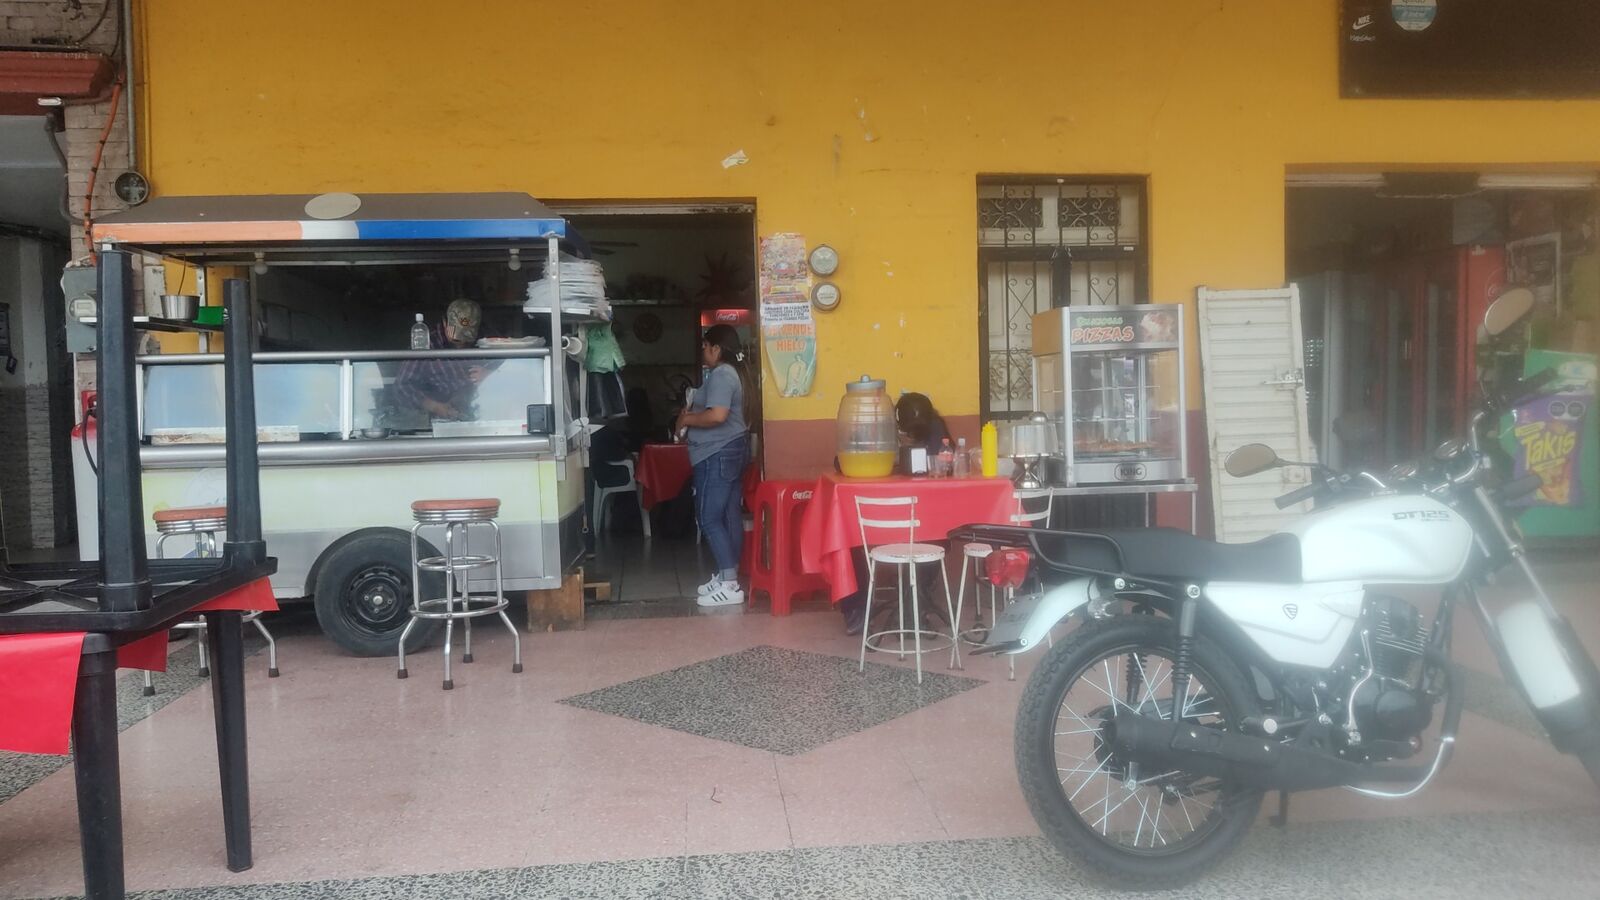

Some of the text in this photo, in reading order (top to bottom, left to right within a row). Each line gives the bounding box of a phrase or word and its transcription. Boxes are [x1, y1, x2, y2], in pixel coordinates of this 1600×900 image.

[1358, 15, 1370, 25] NIKE
[1071, 326, 1135, 343] PIZZAS
[776, 339, 806, 352] HIELO
[1520, 431, 1577, 470] Takis
